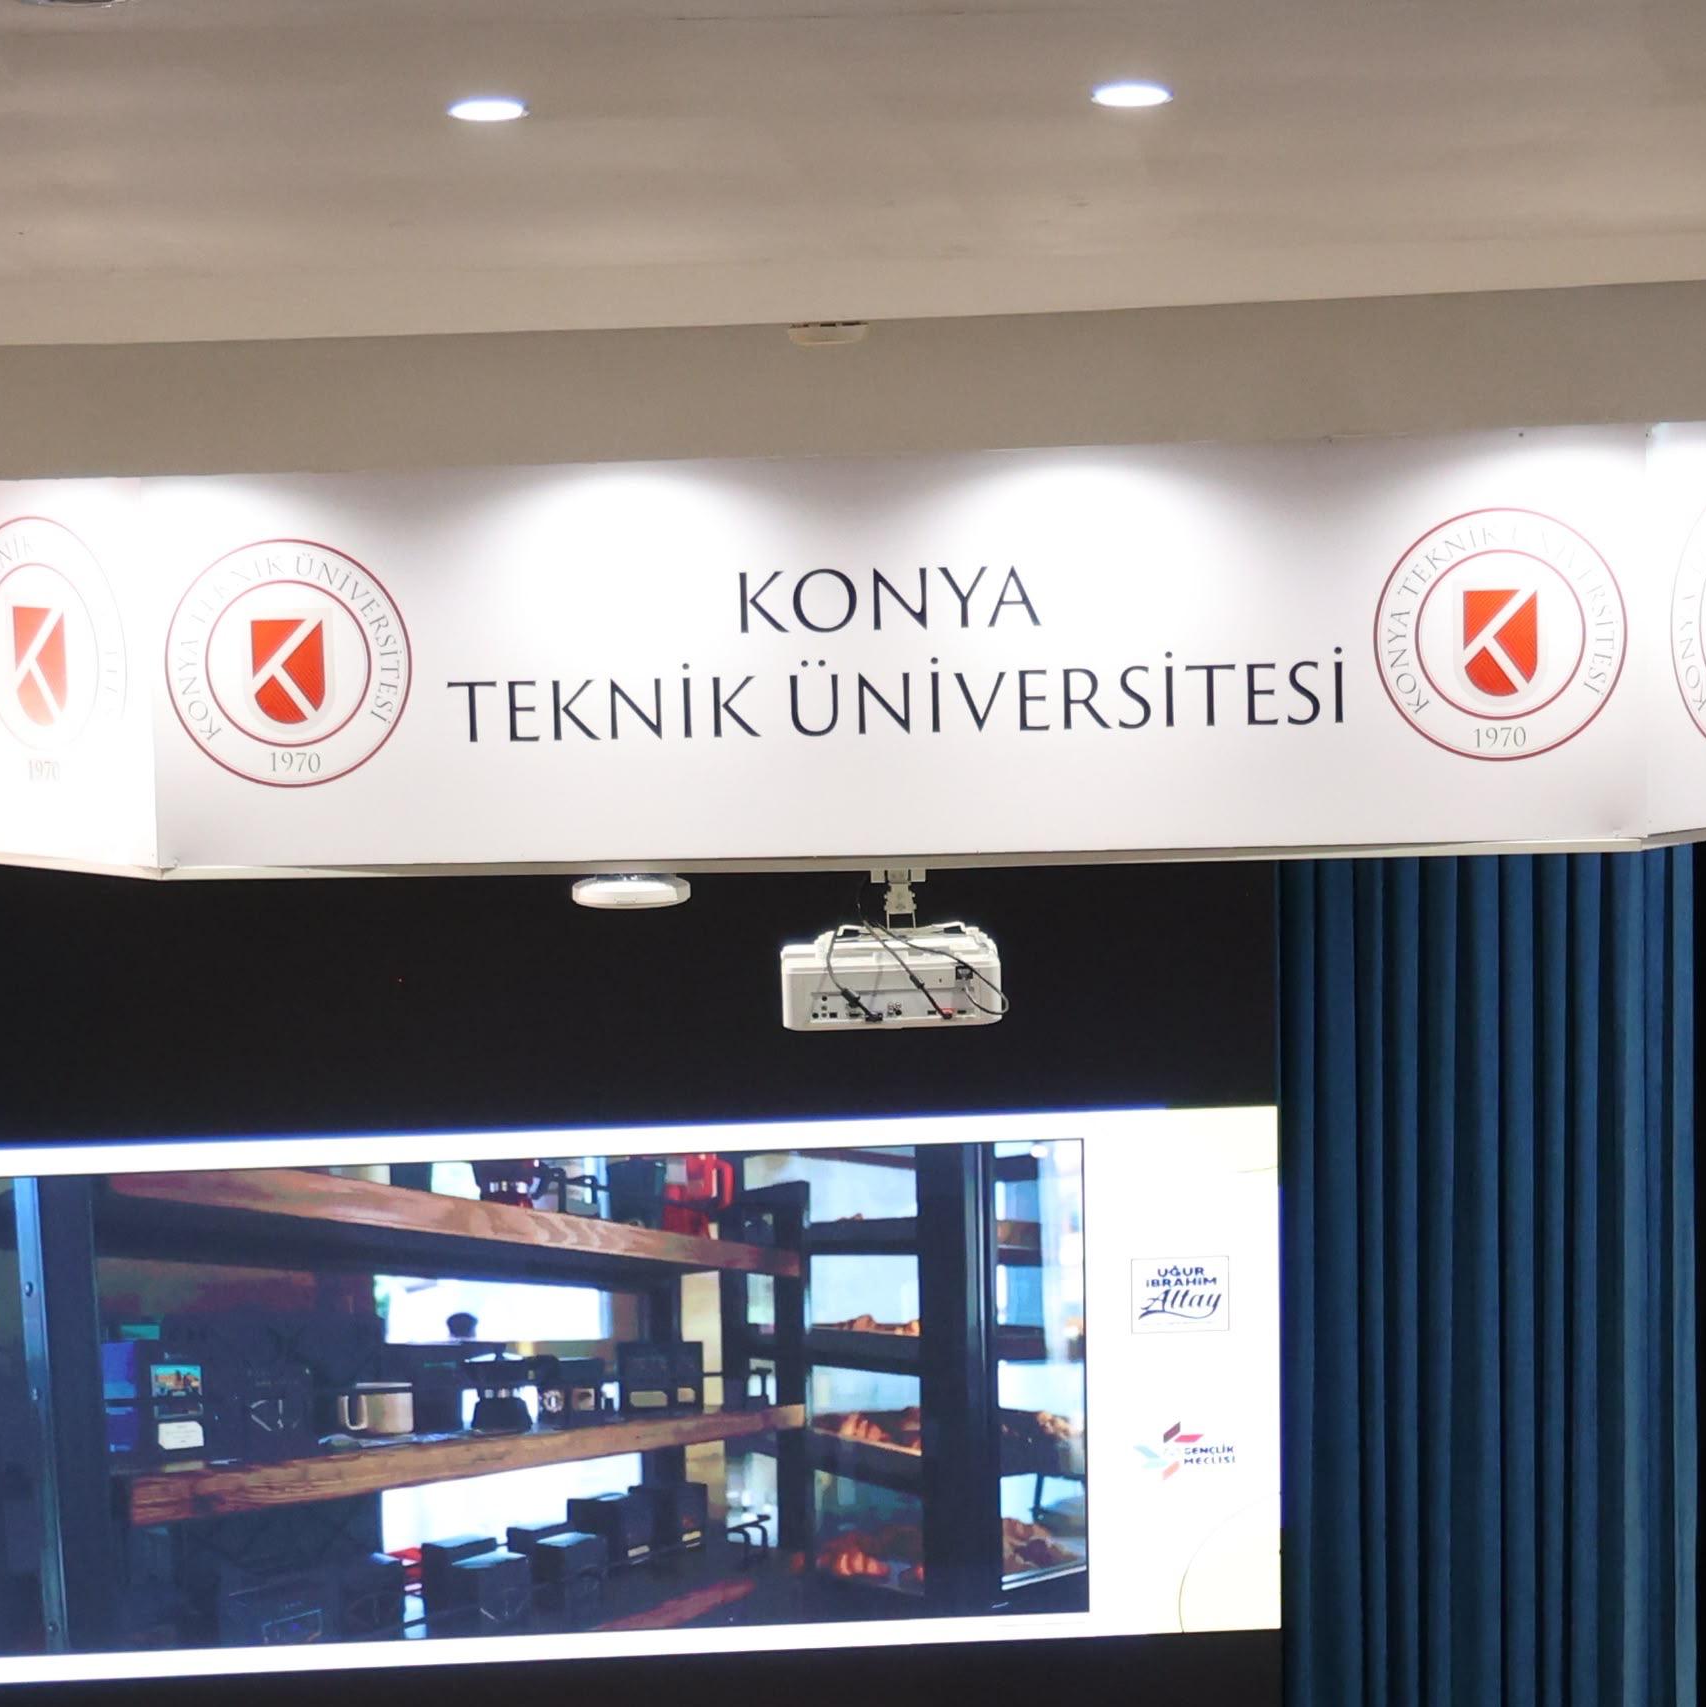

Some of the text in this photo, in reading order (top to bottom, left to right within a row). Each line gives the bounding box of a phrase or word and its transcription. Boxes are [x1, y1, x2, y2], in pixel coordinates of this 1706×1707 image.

[739, 565, 1042, 633] KONYA
[447, 645, 1347, 743] TEKNİK ÜNİVERSİTESİ
[1387, 610, 1430, 714] KONYA
[269, 751, 322, 773] 1970
[1474, 726, 1527, 749] 1970
